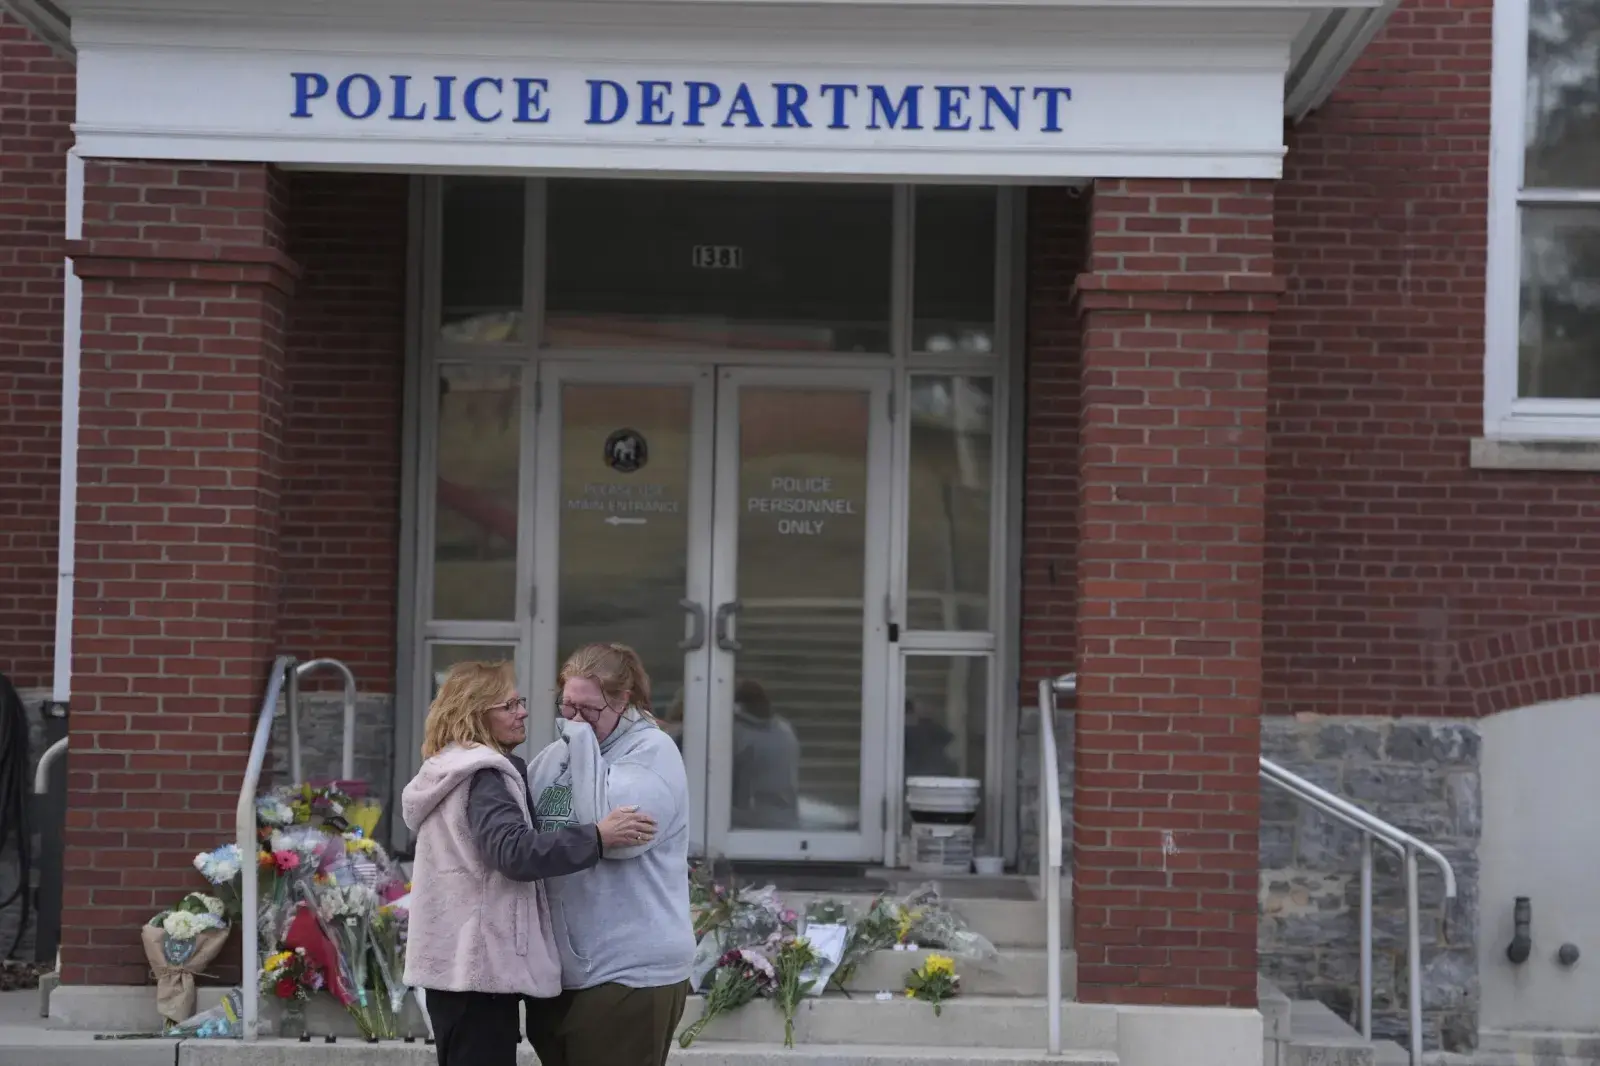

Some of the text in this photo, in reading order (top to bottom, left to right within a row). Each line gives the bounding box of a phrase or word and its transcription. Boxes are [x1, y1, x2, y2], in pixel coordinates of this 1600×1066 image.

[289, 73, 1072, 133] POLICE DEPARTMENT
[694, 245, 741, 268] 1381
[771, 476, 833, 493] POLICE
[568, 499, 680, 513] MAIN ENTRANCE
[748, 497, 857, 514] PERSONNEL
[778, 519, 824, 535] ONLY
